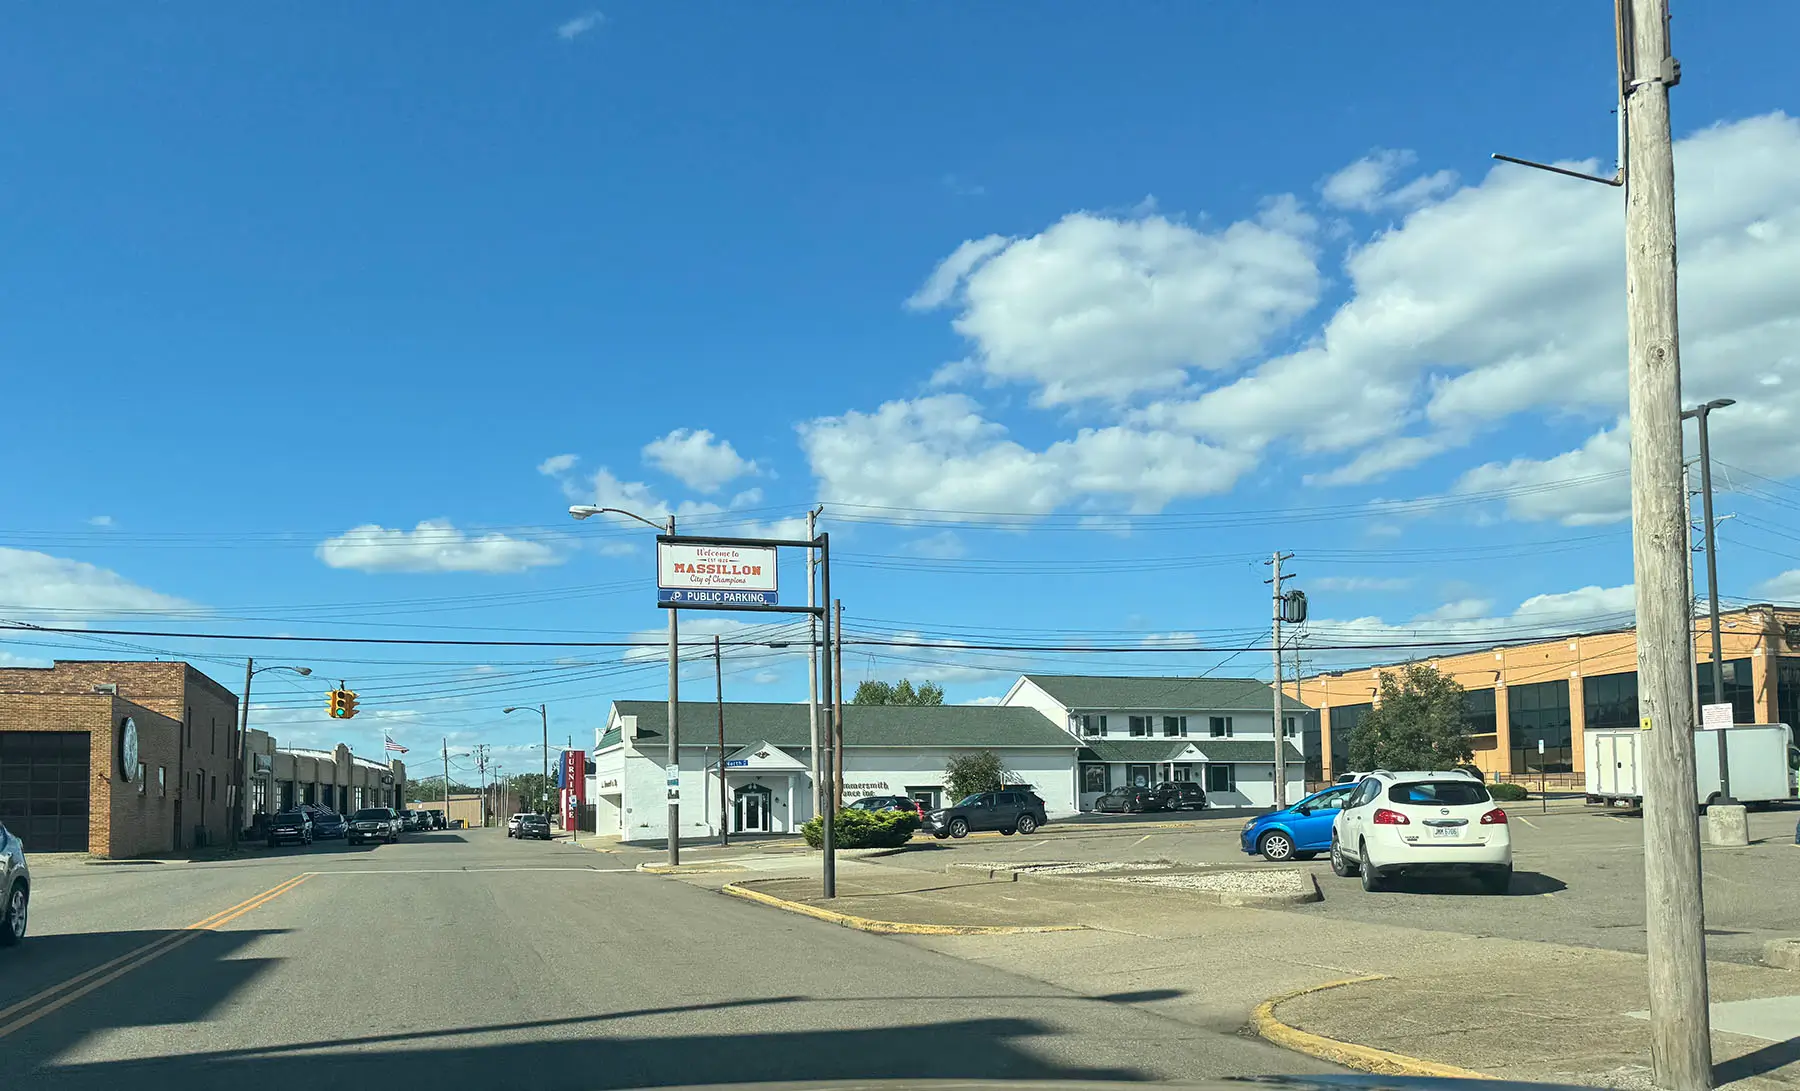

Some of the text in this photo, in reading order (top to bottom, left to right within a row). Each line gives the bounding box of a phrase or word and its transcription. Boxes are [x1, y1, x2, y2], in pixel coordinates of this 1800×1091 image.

[697, 548, 739, 558] Welcome to
[674, 563, 761, 575] MASSILLON
[690, 575, 746, 585] City of Champions
[687, 592, 721, 601] PUBLIC
[724, 593, 764, 602] PARKING
